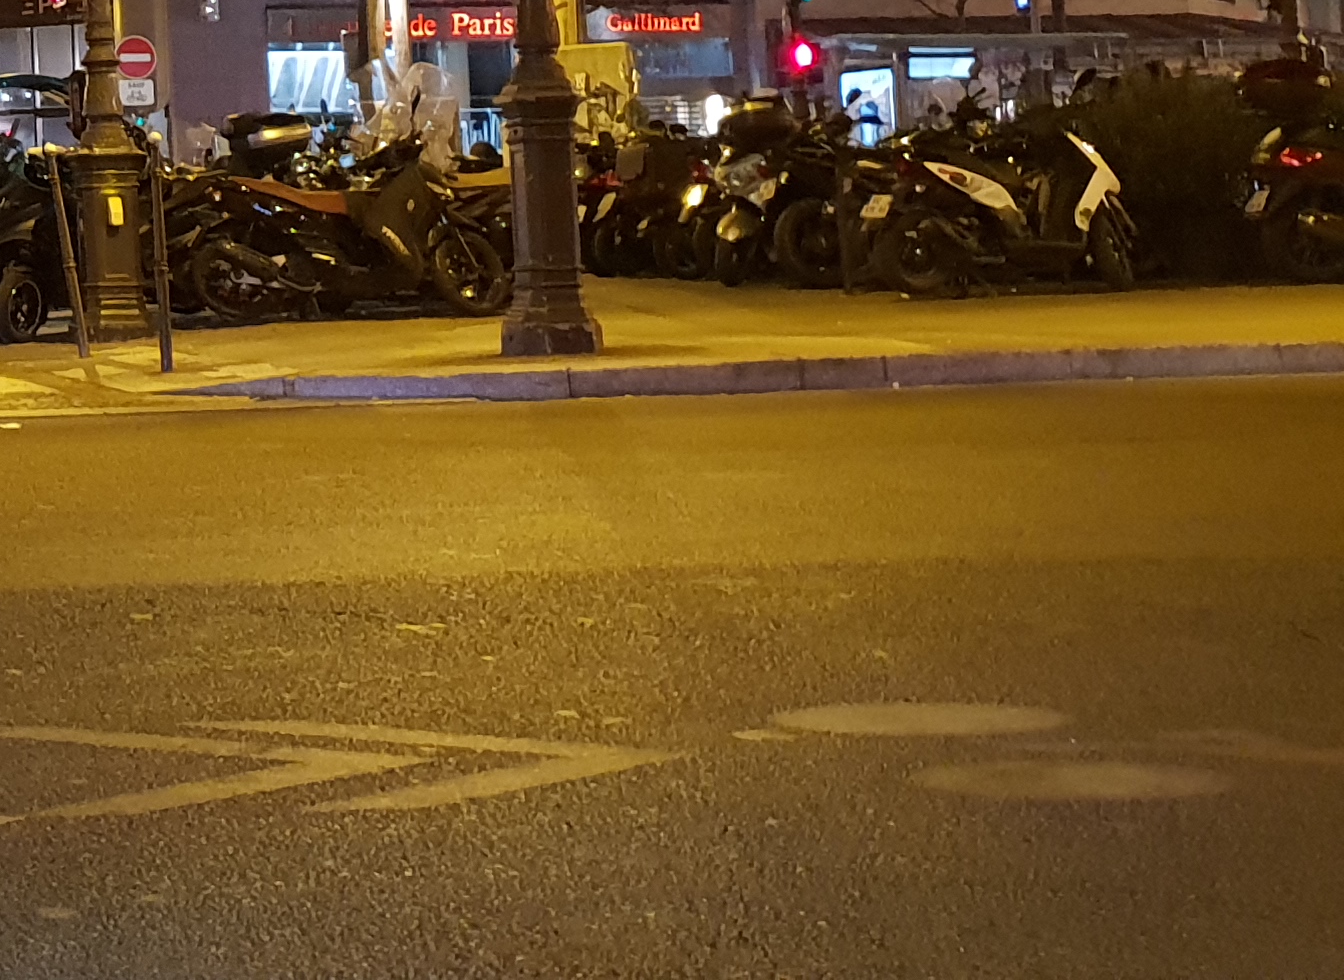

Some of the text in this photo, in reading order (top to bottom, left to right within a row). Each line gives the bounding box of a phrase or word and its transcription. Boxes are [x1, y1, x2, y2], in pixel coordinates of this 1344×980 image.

[410, 13, 437, 37] de
[451, 11, 514, 37] Paris
[606, 11, 702, 33] Gallimard
